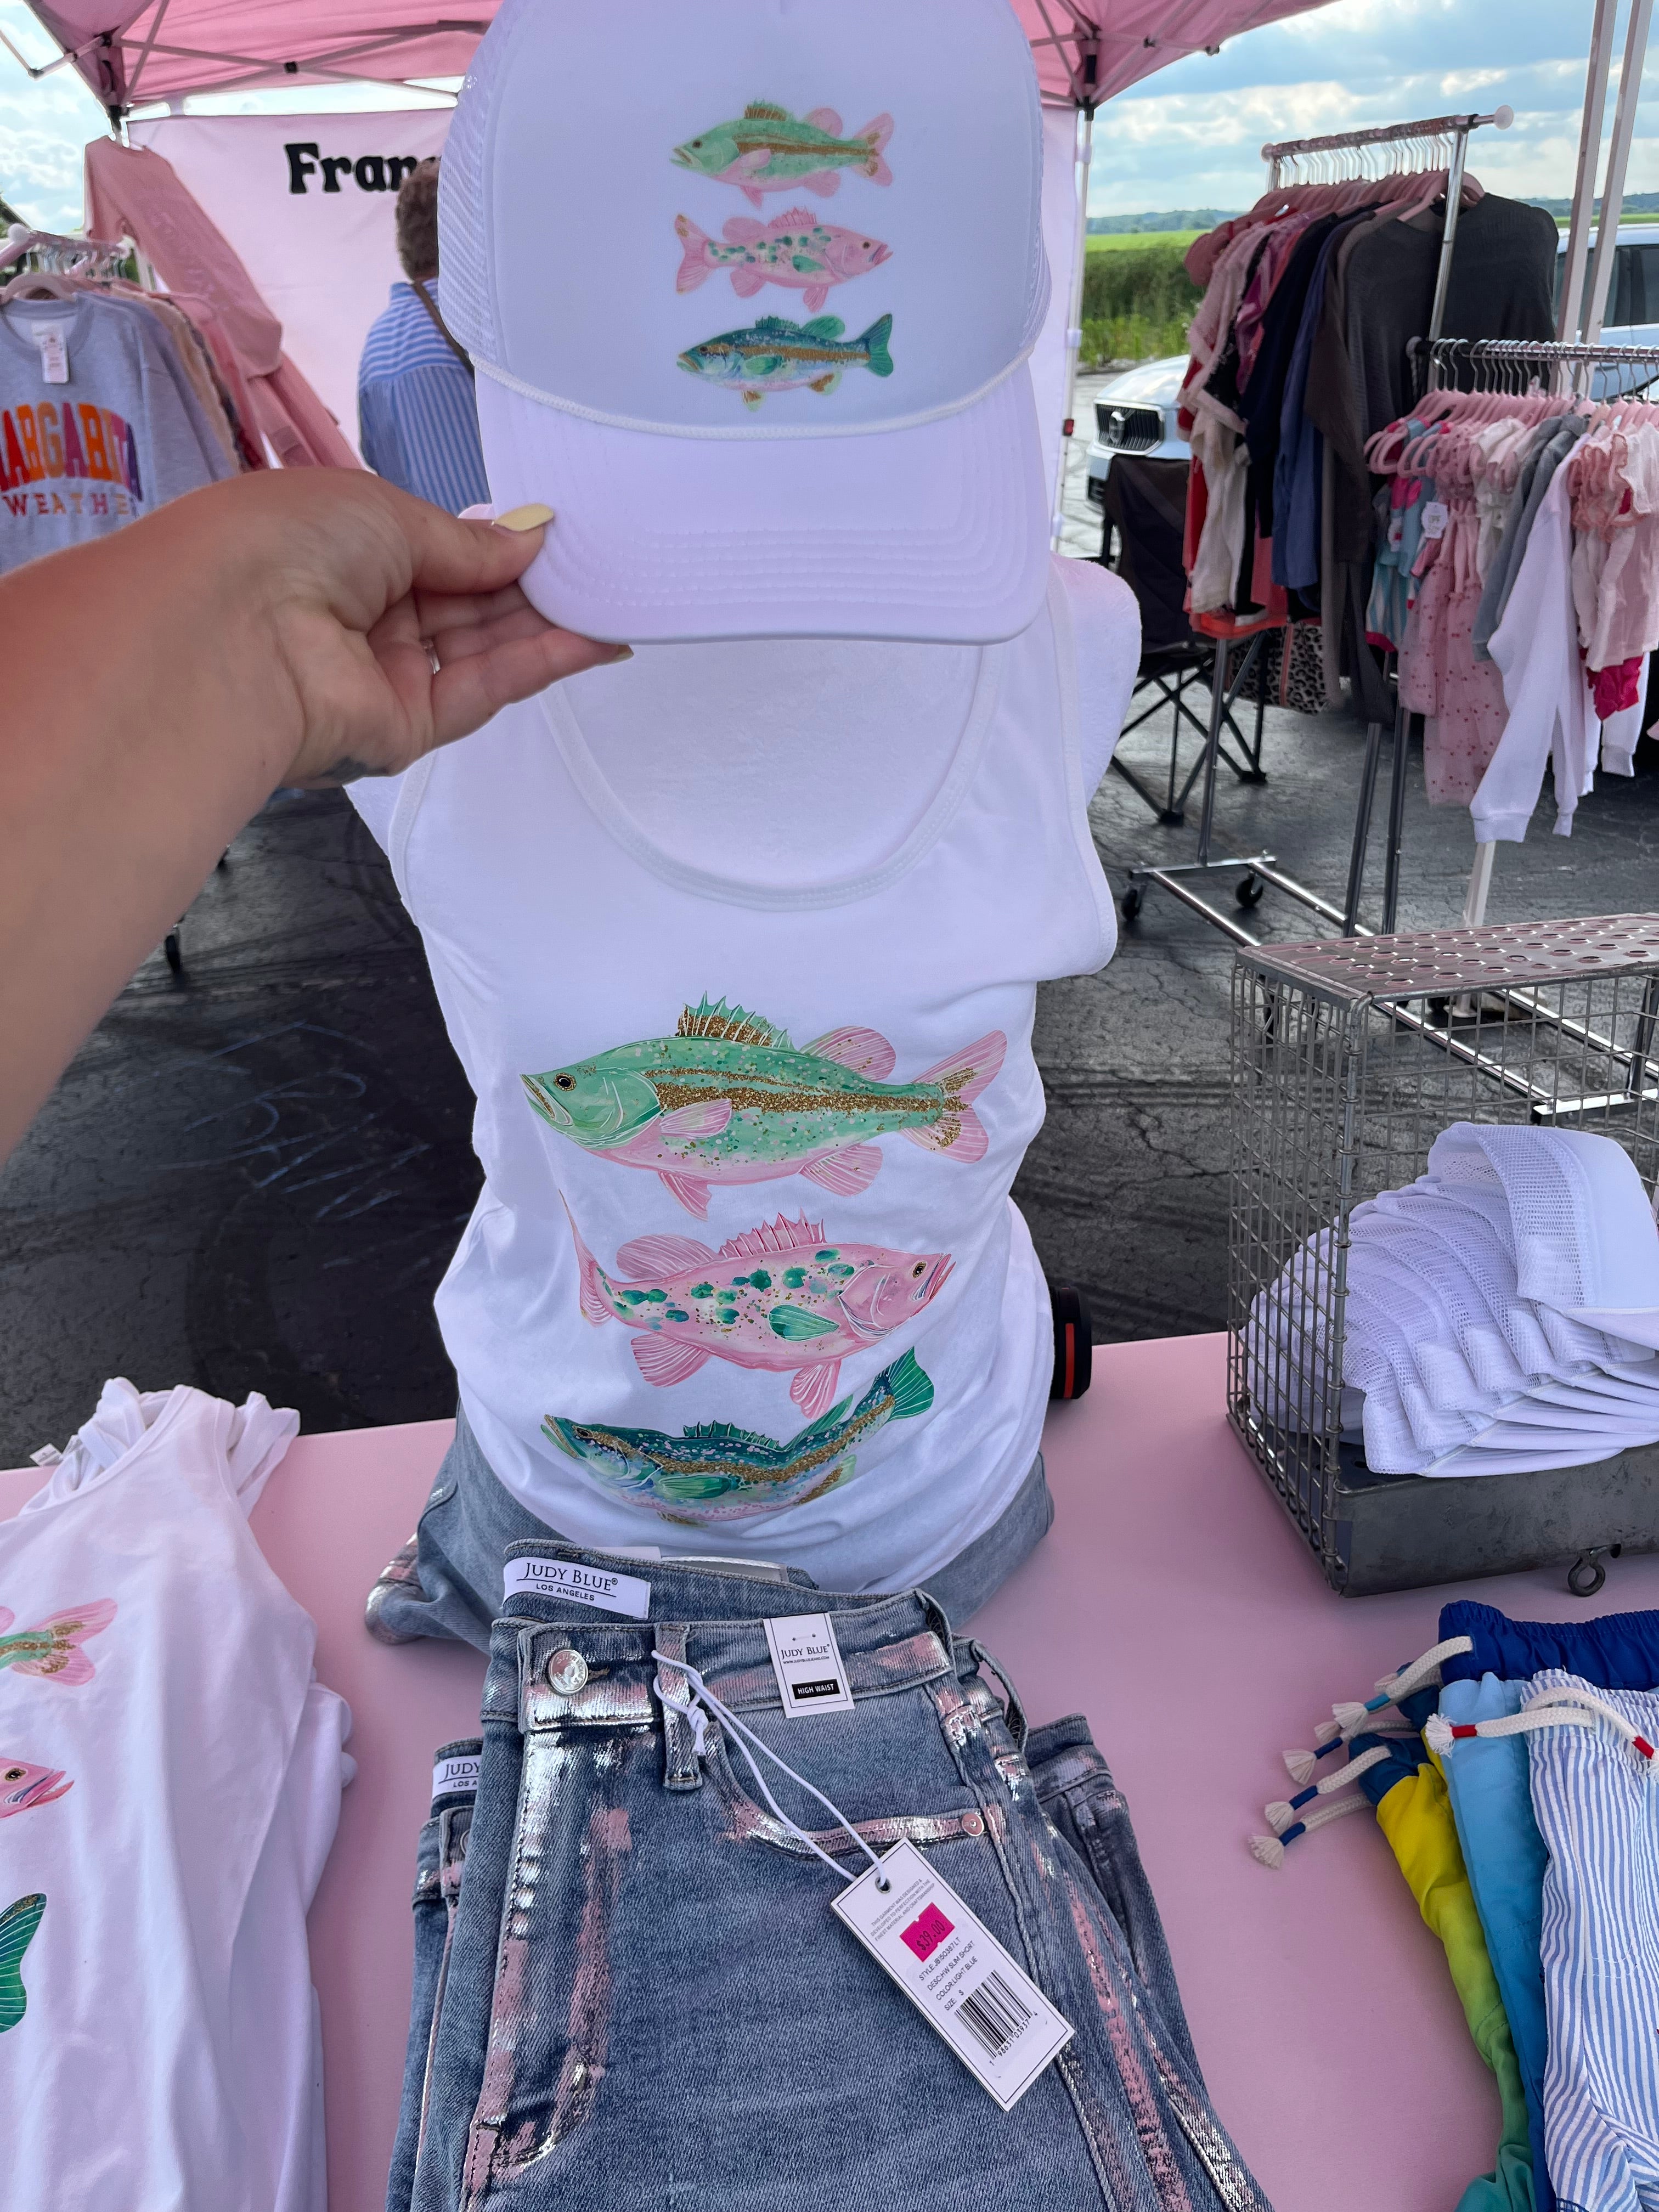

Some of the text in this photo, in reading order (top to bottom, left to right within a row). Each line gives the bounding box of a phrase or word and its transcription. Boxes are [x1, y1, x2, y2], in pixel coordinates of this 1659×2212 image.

[284, 143, 437, 194] Fran
[524, 1562, 567, 1579] JUDY
[556, 1587, 595, 1601] ANGELES
[781, 1648, 803, 1660] JUDY
[797, 1684, 834, 1695] HIGH WAIST
[916, 1920, 945, 1950] $39.00
[948, 1955, 961, 1968] SLIM
[958, 1940, 974, 1958] SHORT
[964, 1955, 978, 1970] BLUE
